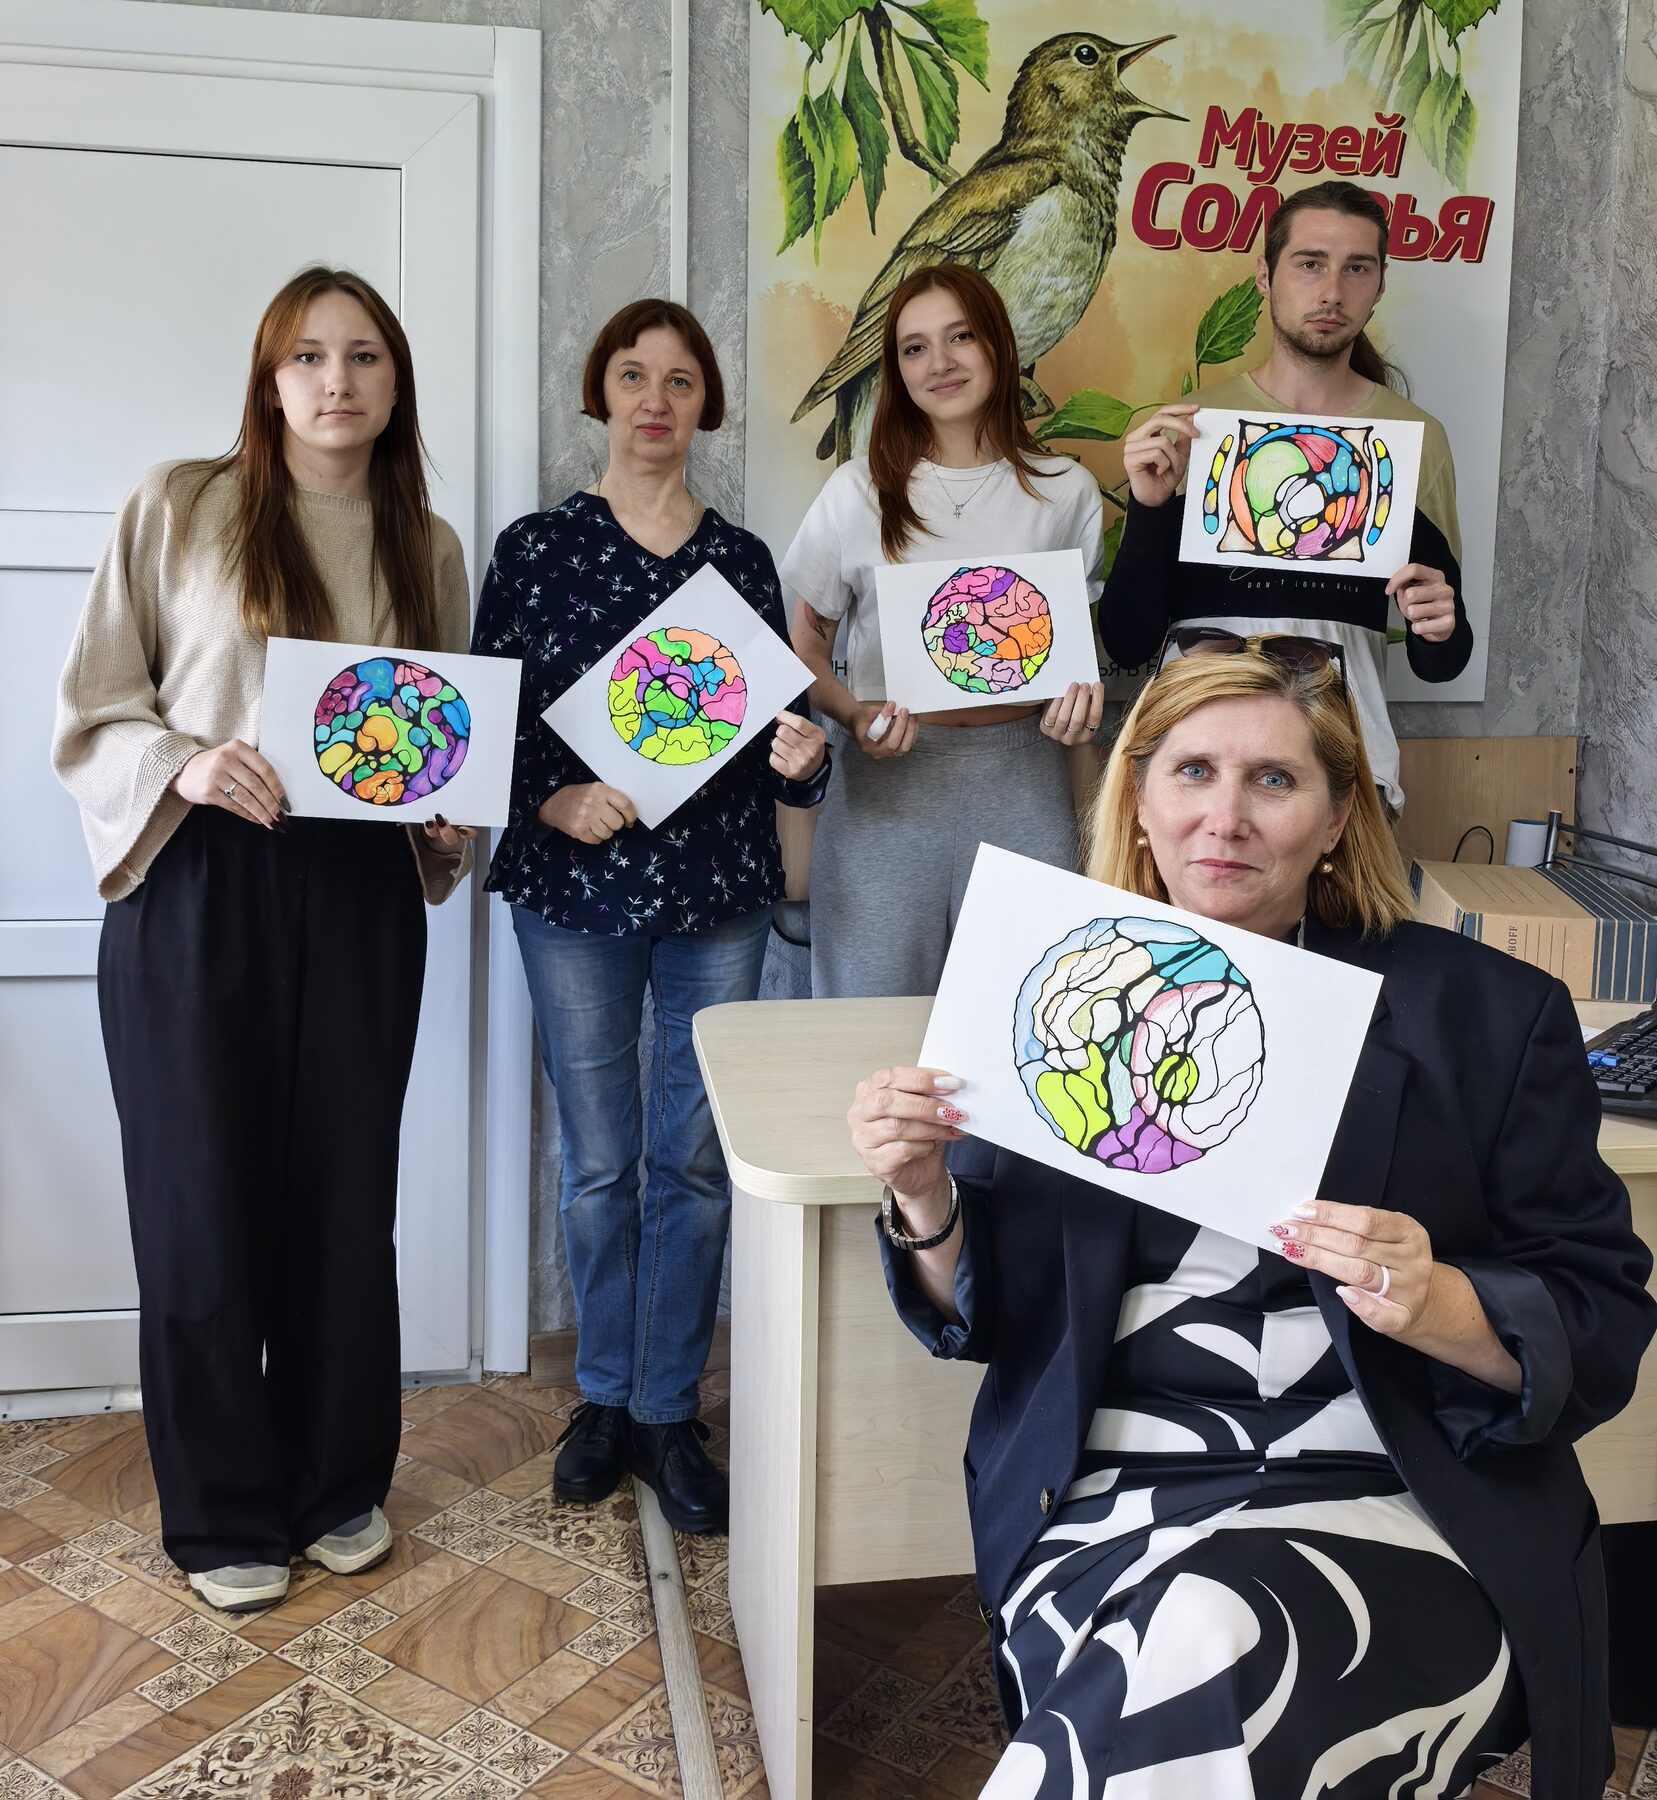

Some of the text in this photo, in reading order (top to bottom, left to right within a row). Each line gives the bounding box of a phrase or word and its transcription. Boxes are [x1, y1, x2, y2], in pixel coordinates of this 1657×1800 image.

[1198, 105, 1406, 185] Музей
[1131, 161, 1495, 264] Солья
[1295, 580, 1325, 589] LOOK
